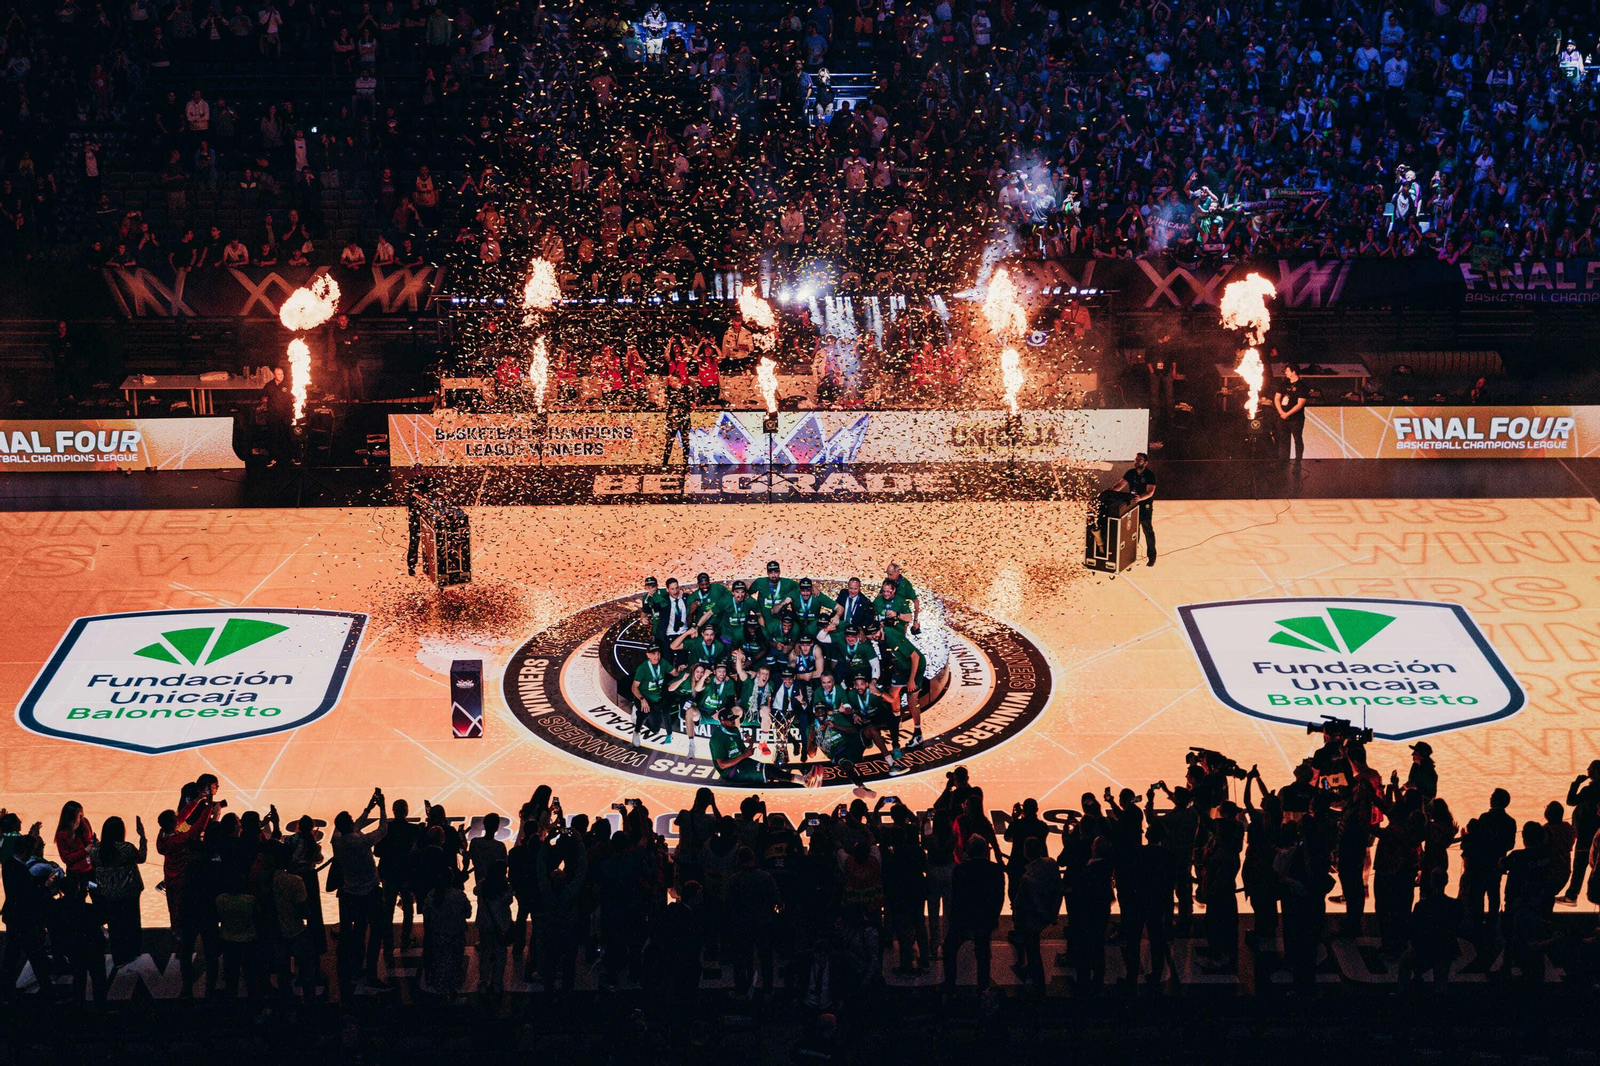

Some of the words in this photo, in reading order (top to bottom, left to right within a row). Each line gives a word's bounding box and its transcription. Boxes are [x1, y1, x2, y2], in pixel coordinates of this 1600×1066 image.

[1459, 261, 1577, 290] FINAL
[1464, 292, 1548, 303] BASKETBALL
[537, 425, 634, 440] HAMPIONS
[1393, 416, 1484, 440] FINAL
[1489, 416, 1575, 440] FOUR
[55, 430, 141, 453] FOUR
[1396, 441, 1461, 450] BASKETBALL
[1462, 440, 1526, 449] CHAMPIONS
[1527, 440, 1568, 449] LEAGUE
[31, 454, 96, 463] CHAMPIONS
[97, 453, 138, 462] LEAGUE
[949, 643, 983, 687] UNICAJA
[1252, 659, 1457, 675] Fundación
[87, 671, 294, 688] Fundación
[518, 658, 555, 718] WINNERS
[1291, 676, 1440, 695] Unicaja
[109, 689, 259, 707] Unicaja
[1268, 693, 1479, 706] Baloncesto
[66, 705, 282, 720] Baloncesto
[951, 692, 1034, 747] WINNERS
[680, 719, 712, 738] FNAL
[537, 715, 648, 767] WINNERS
